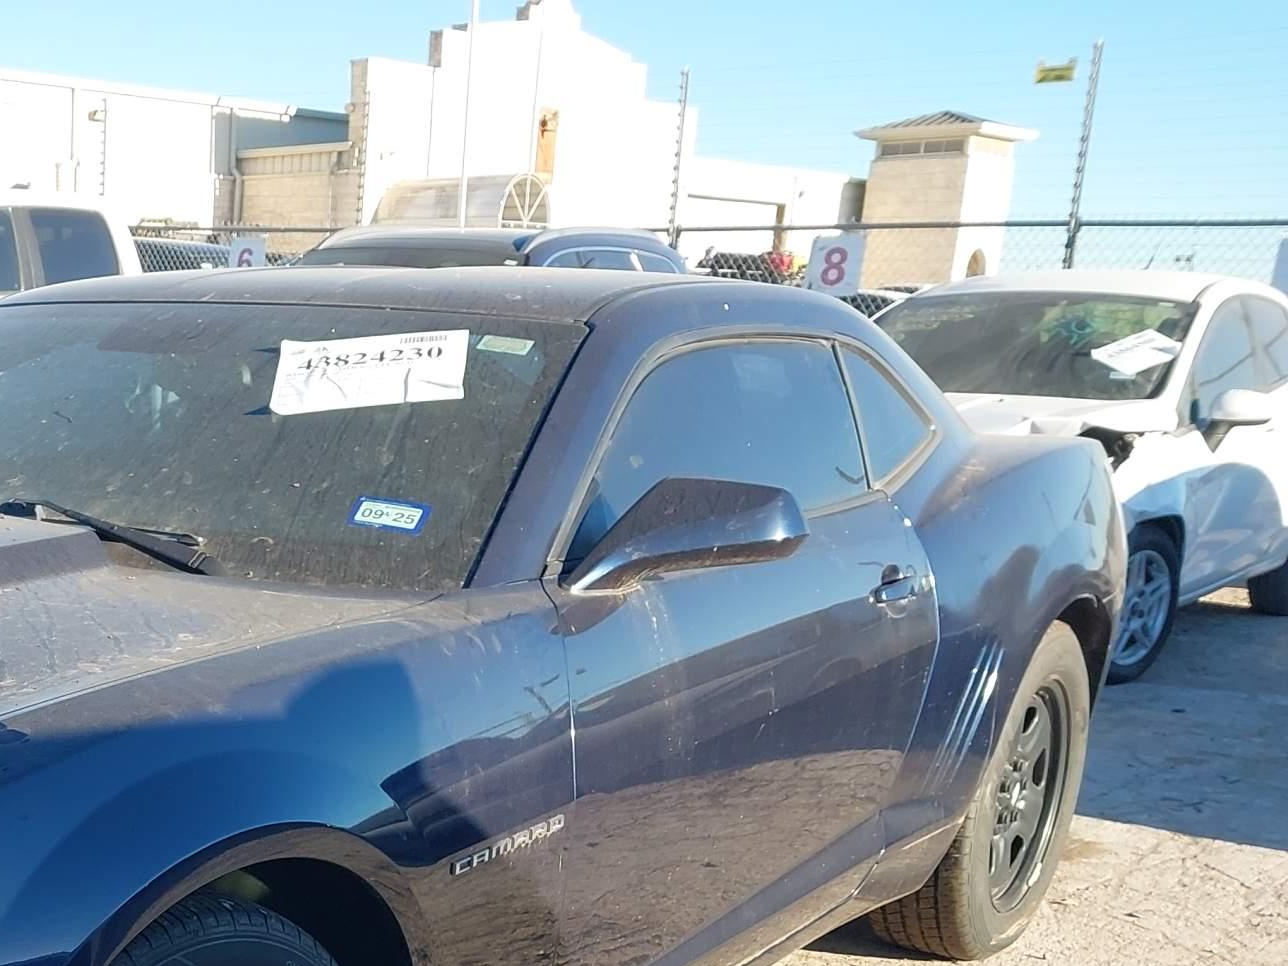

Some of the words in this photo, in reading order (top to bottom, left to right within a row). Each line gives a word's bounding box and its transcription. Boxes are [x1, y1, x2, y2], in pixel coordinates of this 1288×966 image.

[237, 247, 253, 267] 6
[820, 246, 848, 286] 8
[297, 345, 443, 371] 43824230
[360, 507, 385, 519] 09
[392, 512, 417, 524] 25
[452, 813, 565, 876] CAMARO
